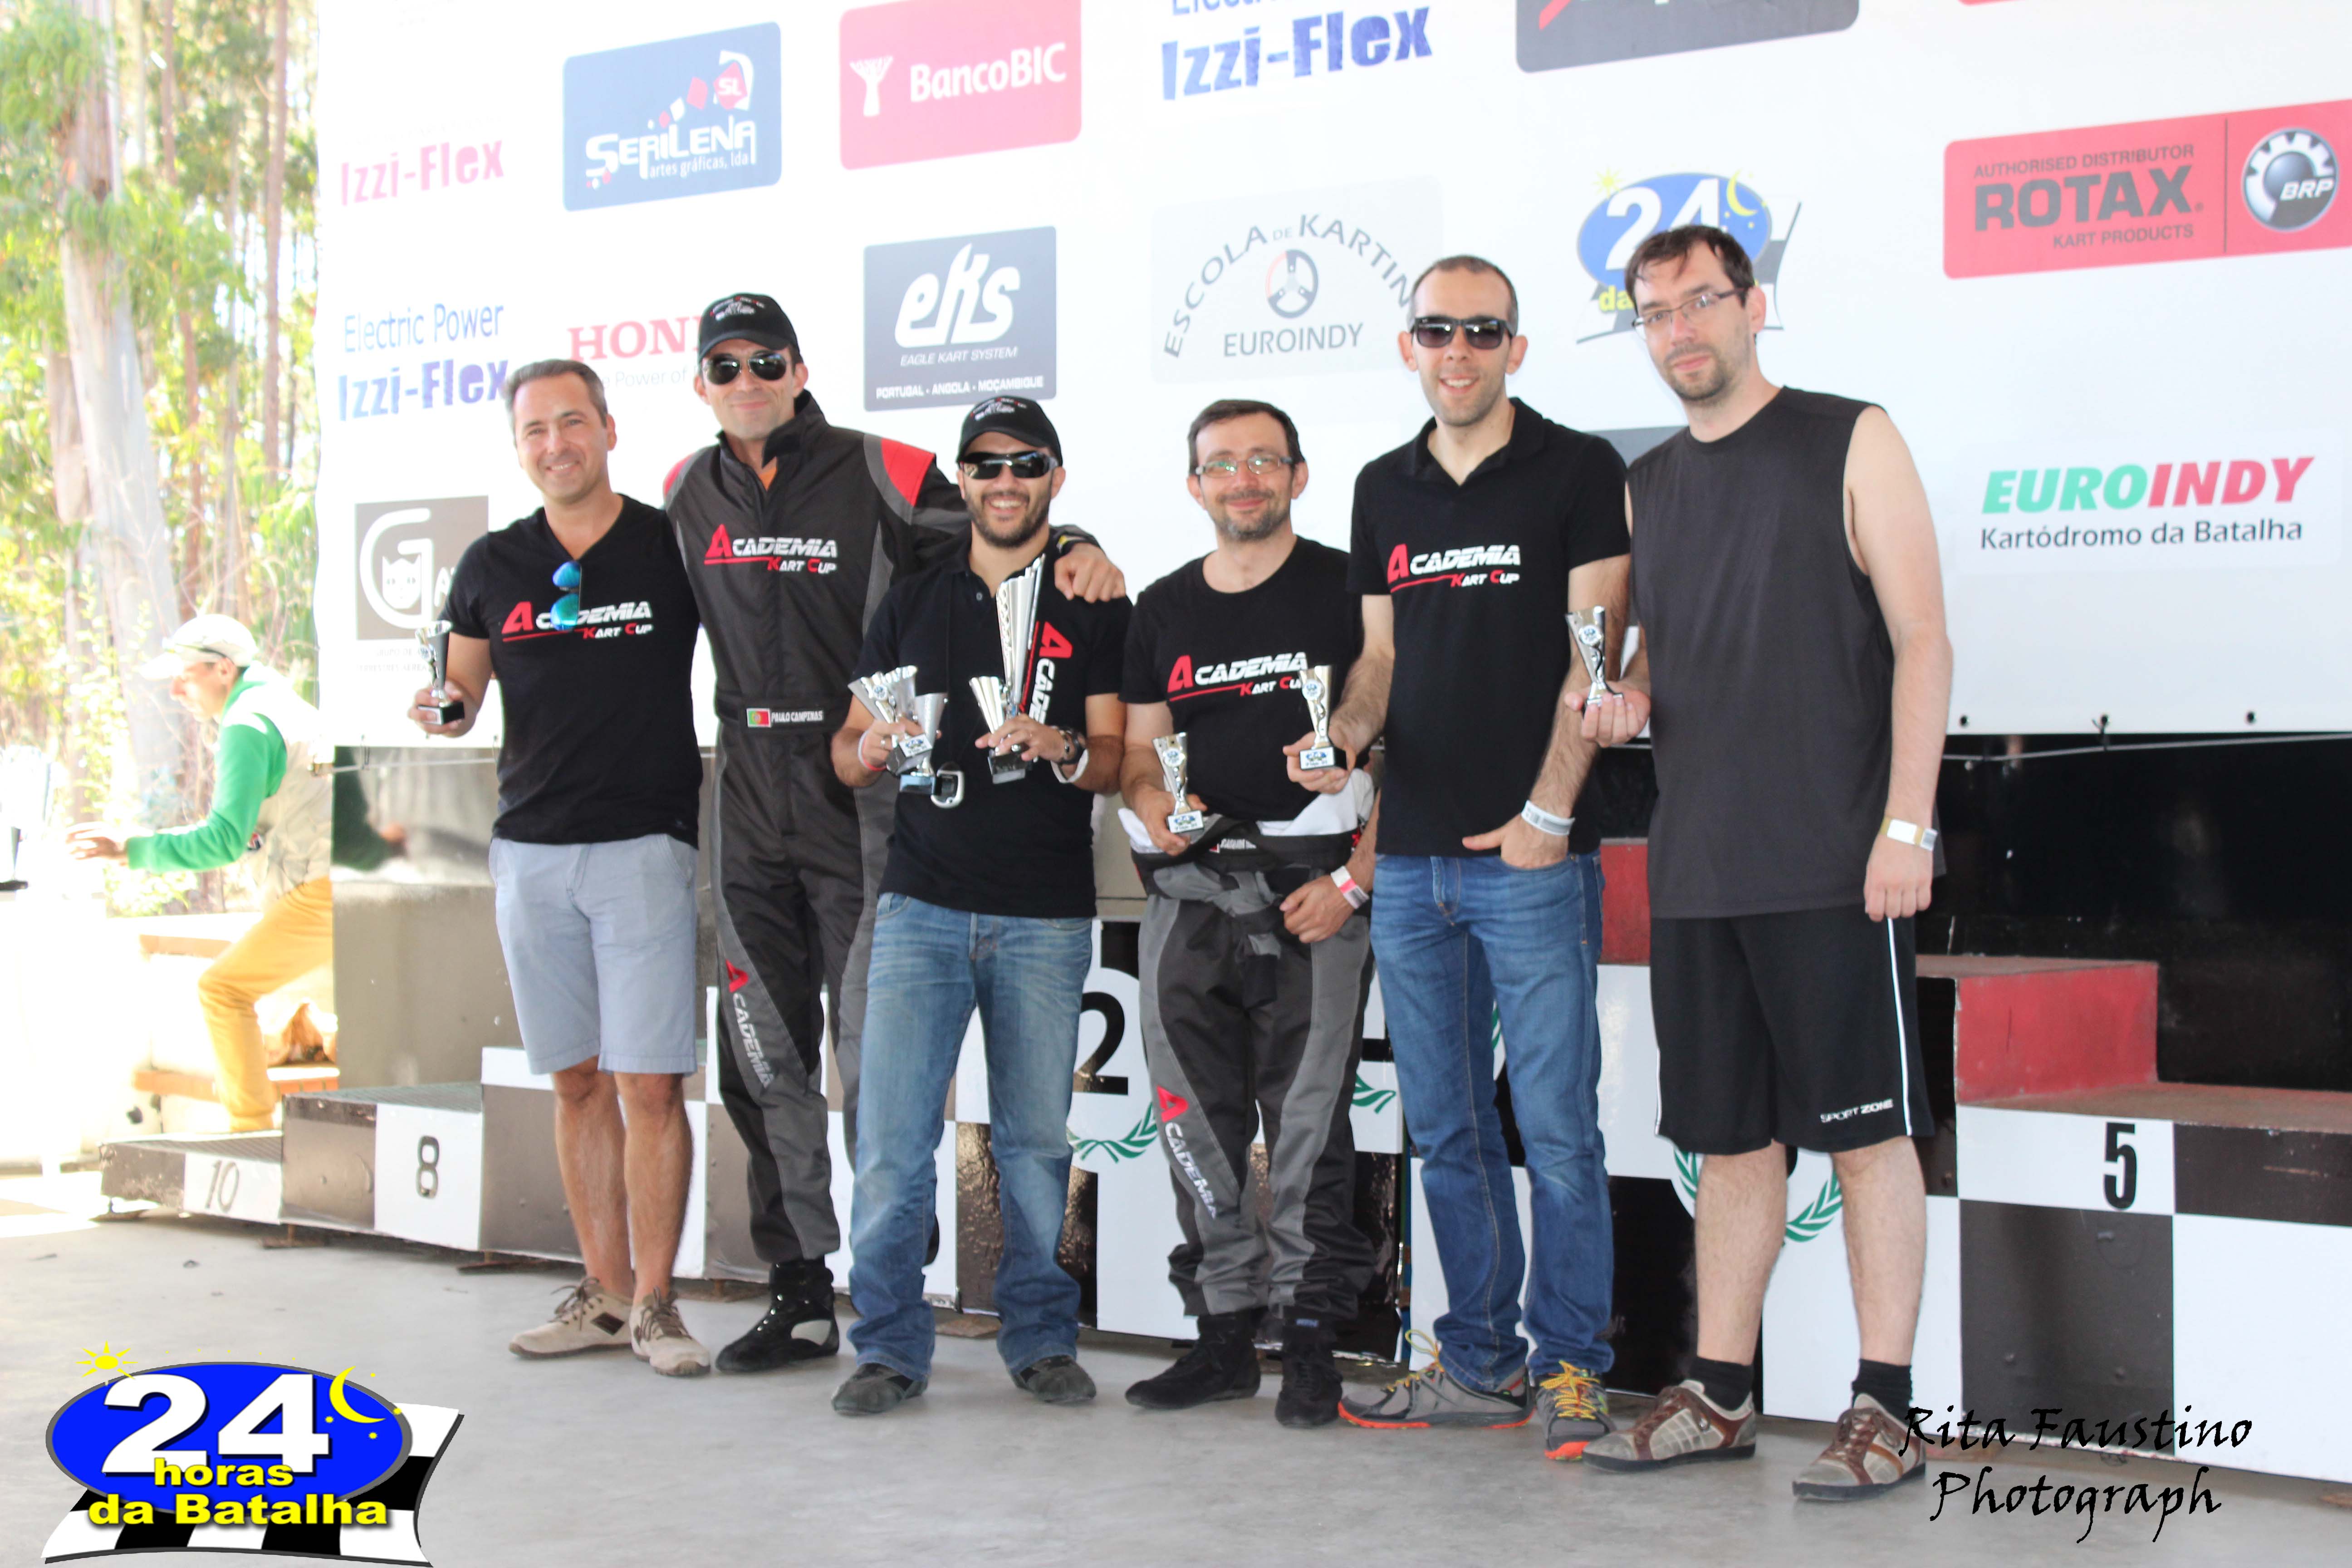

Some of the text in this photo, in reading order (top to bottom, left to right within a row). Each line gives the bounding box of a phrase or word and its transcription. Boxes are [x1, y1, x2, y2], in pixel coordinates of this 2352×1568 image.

[1161, 6, 1432, 100] Izzi-Flex
[718, 78, 742, 96] SL
[910, 42, 1067, 102] BancoBIC
[341, 140, 504, 206] Izzi-Flex
[650, 162, 677, 178] artes
[1974, 144, 2194, 178] AUTHORISED DISTRIBUTOR
[2280, 179, 2334, 201] BRP
[2053, 223, 2194, 249] KART PRODUCTS
[1164, 214, 1411, 358] ESCOLA DE KARTIN
[344, 303, 504, 353] Electric Power
[567, 315, 702, 362] HON
[1224, 323, 1363, 357] EUROINDY
[901, 347, 1018, 367] EAGLE KART SYSTEM
[338, 359, 509, 421] Izzi-Flex
[615, 371, 666, 387] Power
[876, 376, 1044, 399] PORTUGAL ANGOLA MOÇAMBIQUE
[1981, 456, 2315, 514] EUROINDY
[705, 524, 838, 558] ACADEMIA
[1981, 519, 2303, 549] Kartódromo da Batalha
[767, 557, 837, 574] KART CUP
[1387, 544, 1520, 585] ACADEMIA
[1450, 569, 1519, 587] KART CUP
[501, 601, 653, 634] ACDEMIA
[582, 622, 653, 639] KART CUP
[1029, 621, 1073, 725] ACADE
[1167, 652, 1308, 693] ACADEMIA
[1240, 676, 1301, 696] KART CU
[771, 712, 790, 722] PAULO
[726, 959, 774, 1088] ACADEMIA
[1073, 992, 1128, 1096] 2
[1820, 1098, 1893, 1123] SPORT ZONE
[416, 1136, 440, 1198] 8
[1156, 1085, 1217, 1220] ACADEMIA
[2103, 1122, 2137, 1211] 5
[204, 1159, 240, 1212] 10
